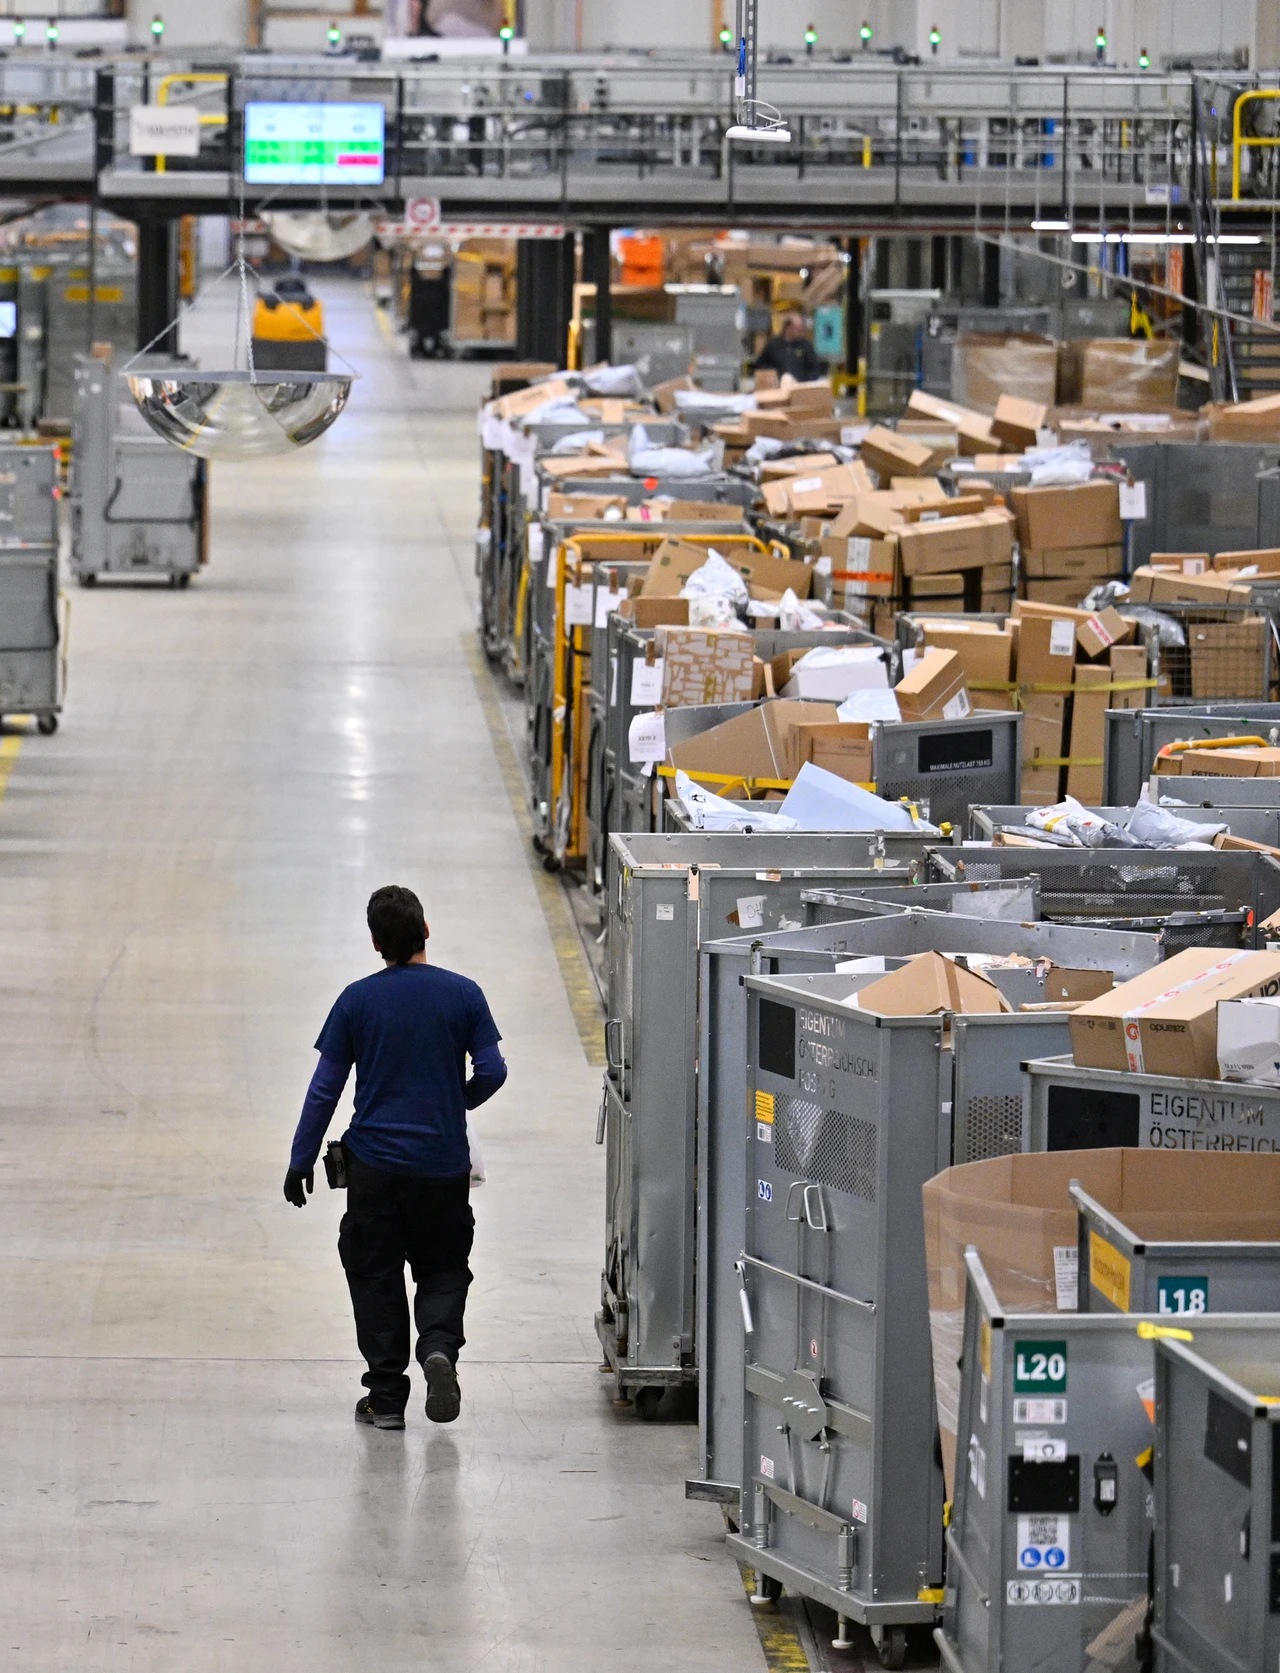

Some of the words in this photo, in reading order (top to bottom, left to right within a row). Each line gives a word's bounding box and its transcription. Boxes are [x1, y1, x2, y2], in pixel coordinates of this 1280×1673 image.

[800, 1008, 846, 1038] EIGENTUM
[1149, 1023, 1186, 1034] zalando
[1150, 1093, 1264, 1127] EIGENTUM
[1159, 1288, 1205, 1313] L18
[1016, 1353, 1066, 1381] L20
